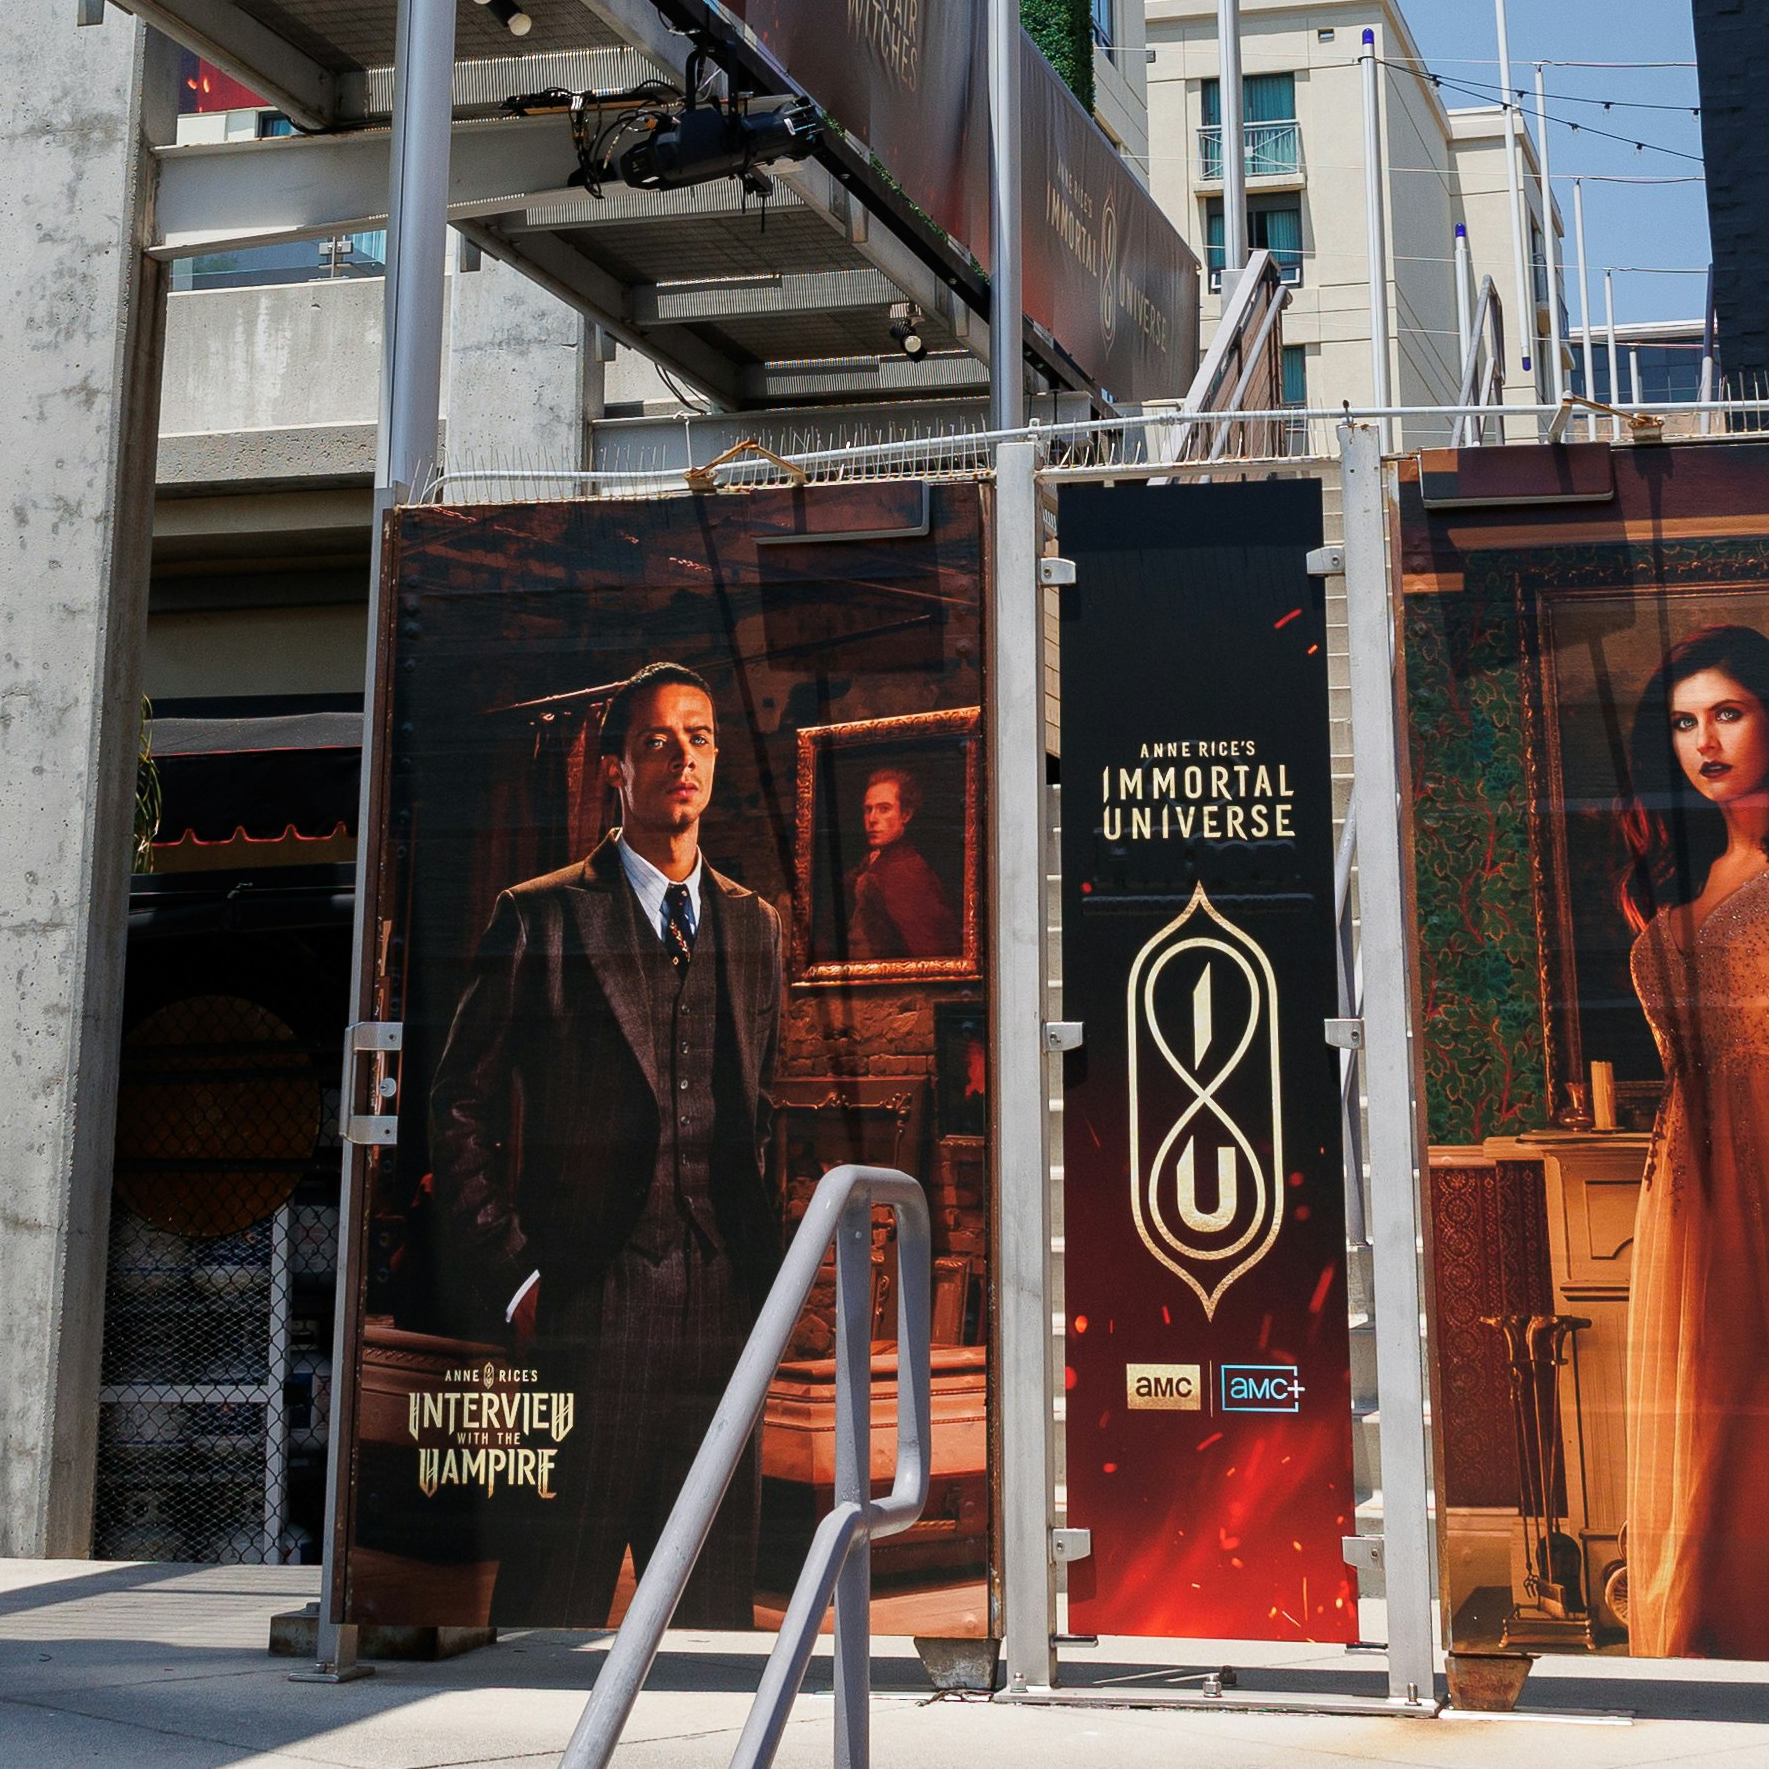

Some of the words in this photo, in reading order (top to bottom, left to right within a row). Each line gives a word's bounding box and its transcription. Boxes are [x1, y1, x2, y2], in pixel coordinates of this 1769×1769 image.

[1046, 181, 1097, 278] IMMORTAL
[1120, 271, 1166, 353] UNIVERSE
[1140, 741, 1191, 758] ANNE
[1198, 740, 1256, 758] RICE'S
[1102, 764, 1295, 804] IMMORTAL
[1103, 803, 1296, 841] UNIVERSE
[444, 1369, 480, 1382] ANNE
[498, 1369, 538, 1382] RICE'S
[408, 1392, 575, 1442] INTERVIEW
[457, 1432, 490, 1445] WITH
[497, 1432, 521, 1445] THE
[418, 1448, 559, 1499] VAMPIRE
